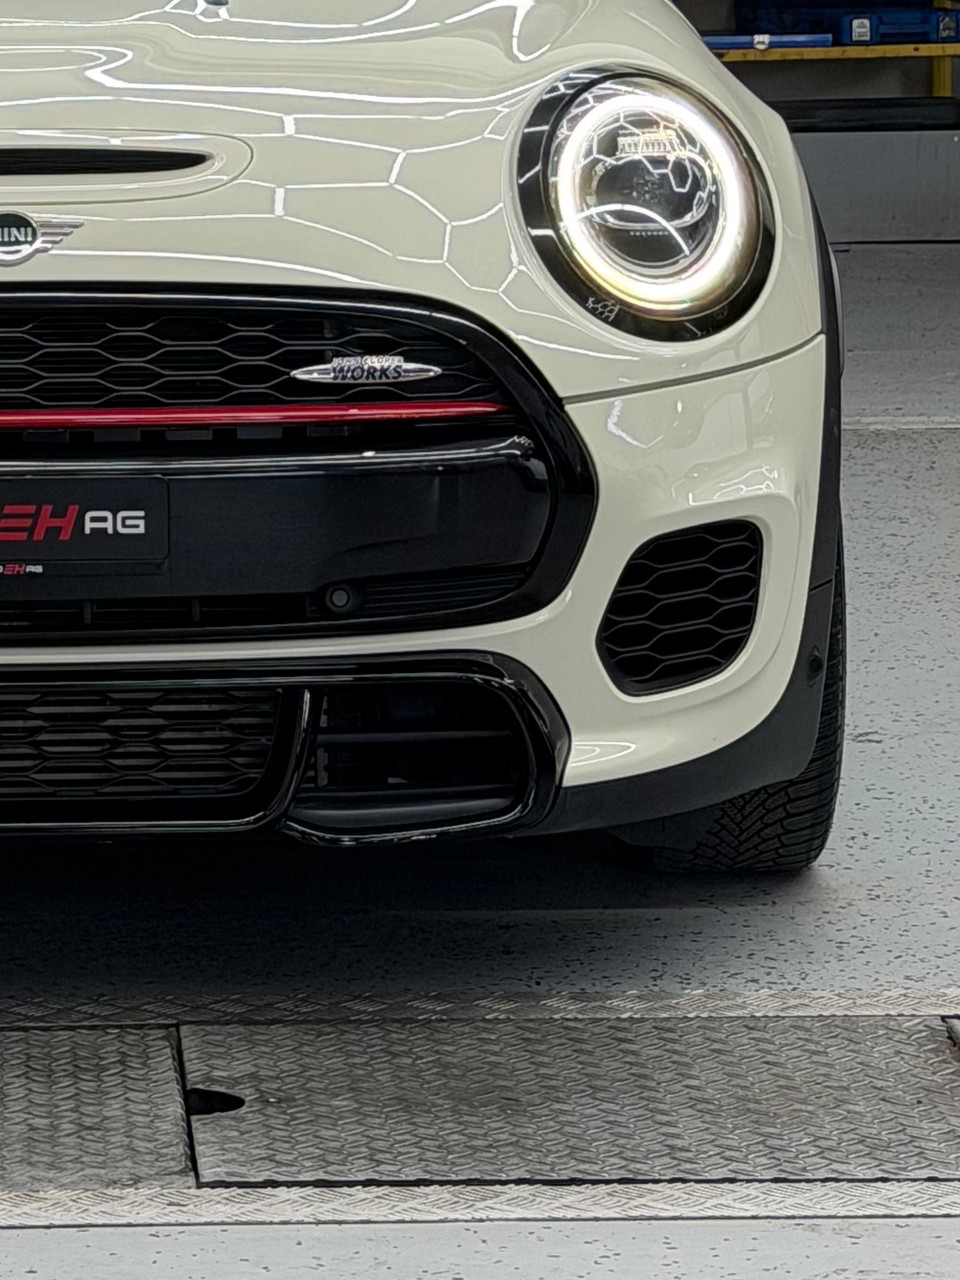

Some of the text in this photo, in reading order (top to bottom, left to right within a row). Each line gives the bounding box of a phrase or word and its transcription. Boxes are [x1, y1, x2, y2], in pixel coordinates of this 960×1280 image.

[332, 365, 403, 381] WORKS
[84, 510, 146, 535] AG
[25, 565, 43, 573] AG
